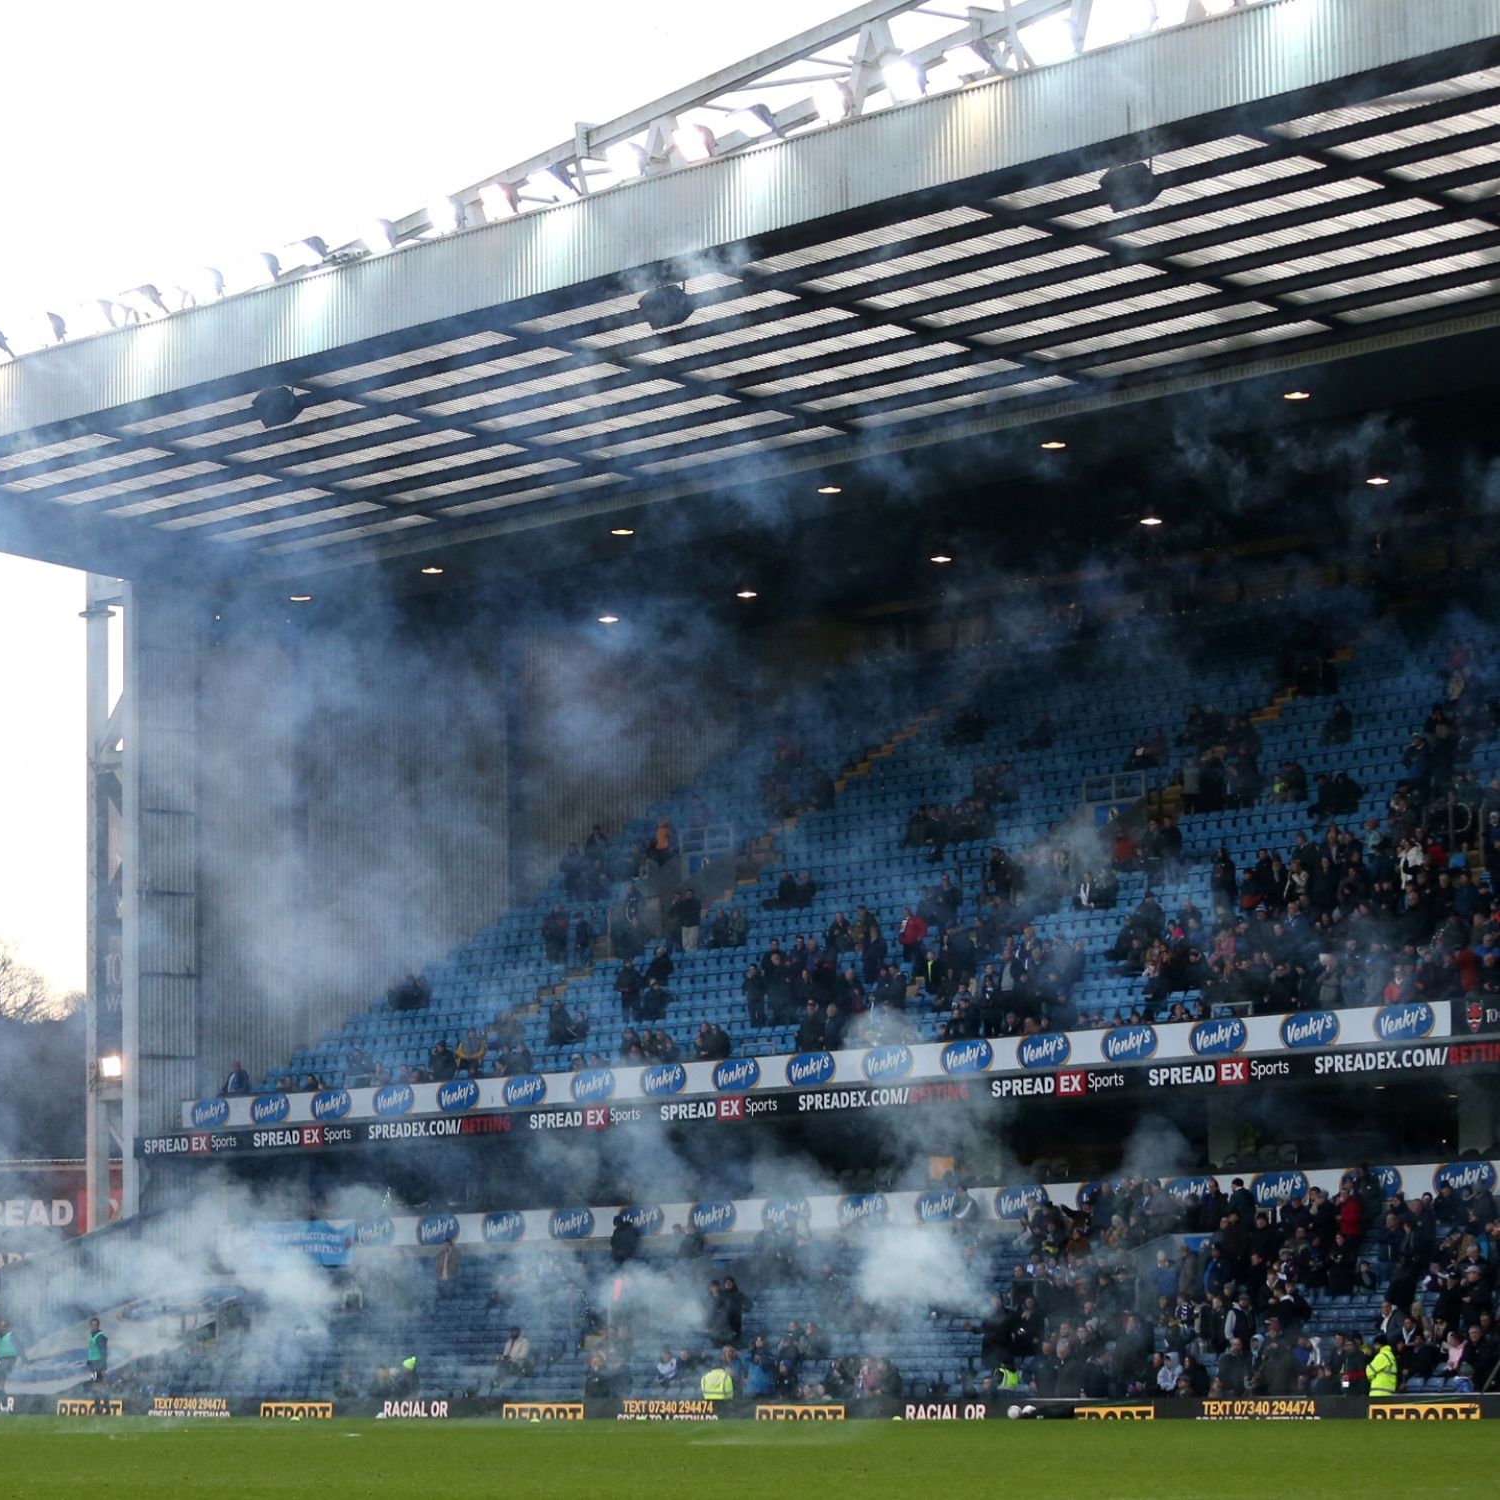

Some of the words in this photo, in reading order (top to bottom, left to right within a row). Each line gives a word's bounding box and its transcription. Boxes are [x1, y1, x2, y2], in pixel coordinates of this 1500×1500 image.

[1287, 1014, 1333, 1043] Venky's
[1381, 1007, 1427, 1039] Venky's
[1108, 1029, 1151, 1058] Venky's
[1196, 1022, 1240, 1051] Venky's
[867, 1049, 907, 1076] Venky's
[946, 1044, 987, 1071] Venky's
[1022, 1037, 1064, 1065] Venky's
[645, 1066, 682, 1091] Venky's
[717, 1059, 755, 1086] Venky's
[791, 1055, 830, 1081] Venky's
[1148, 1065, 1215, 1086] SPREAD
[1220, 1062, 1243, 1081] EX
[1250, 1060, 1289, 1080] Sports
[441, 1083, 475, 1106] Venky's
[507, 1078, 542, 1102] Venky's
[575, 1072, 610, 1096] Venky's
[992, 1077, 1054, 1097] SPREAD
[1059, 1074, 1082, 1093] EX
[1087, 1073, 1124, 1093] Sports
[254, 1097, 287, 1120] Venky's
[315, 1093, 348, 1116] Venky's
[377, 1088, 410, 1110] Venky's
[661, 1101, 716, 1120] SPREAD
[721, 1100, 740, 1117] EX
[745, 1098, 777, 1116] Sports
[195, 1102, 226, 1124] Venky's
[530, 1111, 582, 1129] SPREAD
[586, 1110, 604, 1126] EX
[610, 1106, 640, 1124] Sports
[144, 1137, 188, 1154] SPREAD
[192, 1136, 207, 1151] EX
[211, 1135, 237, 1151] Sports
[253, 1130, 299, 1147] SPREAD
[304, 1128, 320, 1144] EX
[324, 1127, 351, 1143] Sports
[1257, 1173, 1301, 1204] Venky's
[693, 1204, 731, 1228] Venky's
[843, 1197, 882, 1222] Venky's
[357, 1222, 390, 1244] Venky's
[421, 1218, 454, 1241] Venky's
[486, 1214, 521, 1237] Venky's
[553, 1210, 588, 1234] Venky's
[154, 1397, 173, 1409] TEXT
[384, 1401, 429, 1418] RACIAL
[431, 1401, 448, 1418] OR
[623, 1401, 647, 1413] TEXT
[648, 1401, 677, 1413] 07340
[679, 1401, 713, 1413] 294474
[964, 1404, 985, 1420] OR
[1202, 1400, 1232, 1416] TEXT
[1234, 1400, 1269, 1416] 07340
[1271, 1400, 1316, 1415] 294474
